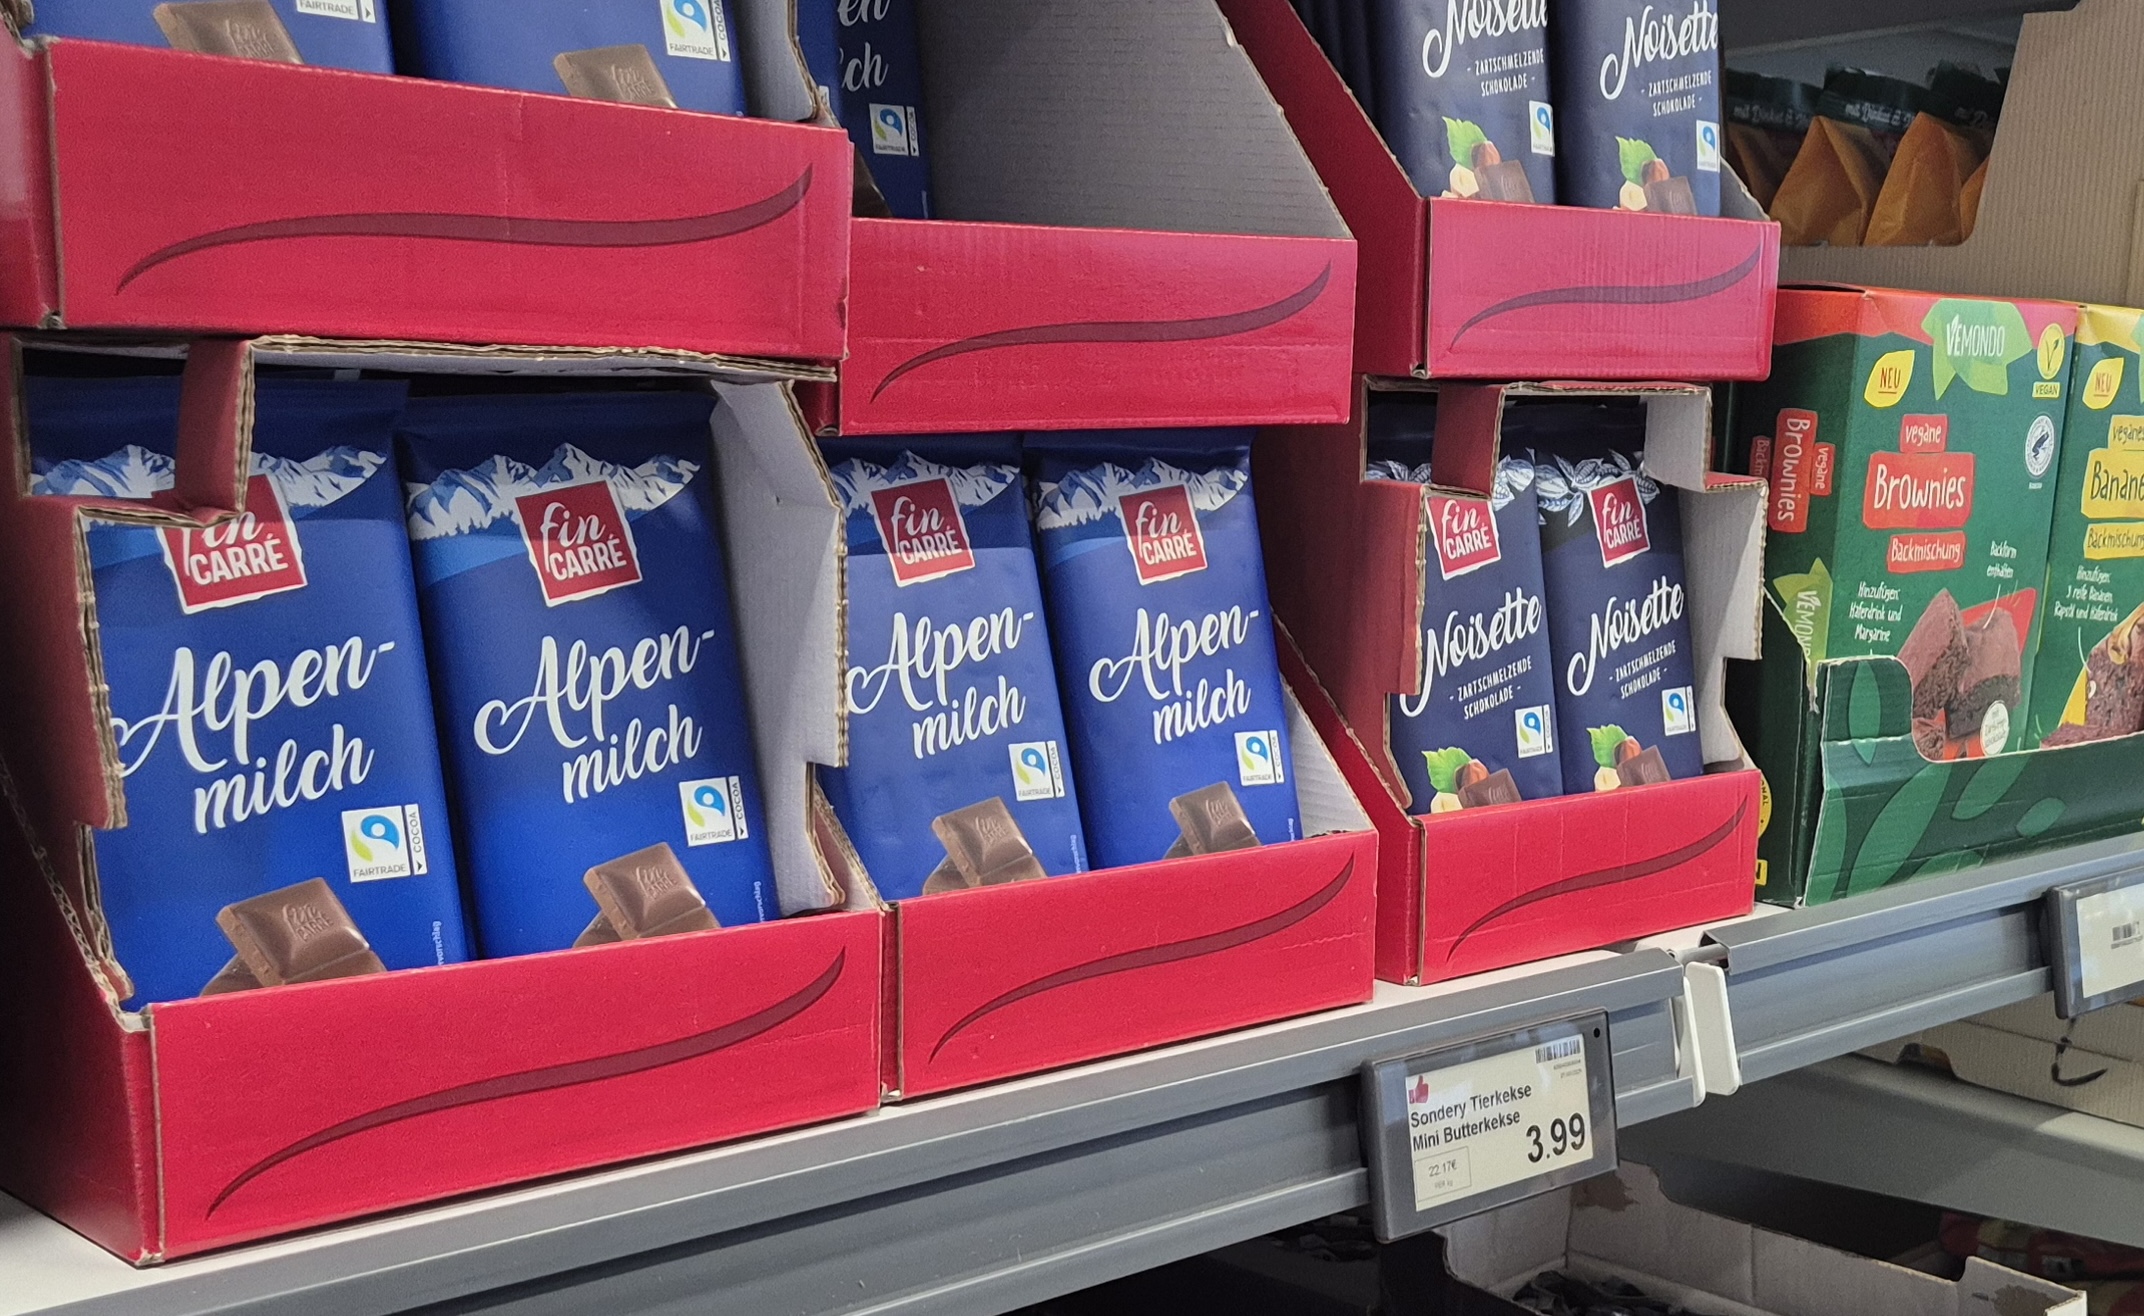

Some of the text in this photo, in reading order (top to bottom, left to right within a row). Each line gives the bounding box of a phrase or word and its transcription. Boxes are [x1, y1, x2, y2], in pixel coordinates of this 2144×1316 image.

[299, 0, 356, 15] FAIRTRADE
[669, 43, 714, 56] FAIRTRADE
[1474, 48, 1545, 76] ZARTSCHMELZENDE
[1481, 73, 1528, 97] SCHOKOLADE
[1648, 70, 1712, 97] ZARTSCHMELZENDE
[1653, 95, 1696, 117] SCHOKOLADE
[1946, 313, 2006, 357] VEMONDO
[1879, 366, 1902, 389] NEU
[2035, 384, 2059, 396] VEGAN
[2094, 372, 2112, 393] NEU
[1905, 423, 1942, 447] vegane
[1777, 418, 1811, 522] Brownies
[1815, 447, 1829, 490] vegane
[1873, 463, 1966, 511] Brownies
[540, 502, 607, 573] fin
[891, 496, 944, 557] fin
[1135, 501, 1182, 559] fin
[1441, 499, 1480, 554] fin
[1602, 492, 1635, 544] fin
[1606, 514, 1643, 550] CARRÉ
[190, 533, 289, 586] CARRÉ
[549, 533, 627, 581] CARRÉ
[899, 525, 962, 565] CARRÉ
[1142, 530, 1197, 565] CARRÉ
[1445, 522, 1492, 560] CARRÉ
[1891, 537, 1961, 563] Backmischung
[1849, 601, 1903, 622] Haferdrink und
[1088, 605, 1259, 702] Alpen-
[1400, 587, 1542, 718] Noisette
[1566, 575, 1684, 696] Noisette
[1854, 623, 1891, 644] Margarine
[845, 607, 1035, 714] Alpen-
[1457, 655, 1533, 702] ZARTSCHMELZENDE
[1615, 640, 1677, 680] ZARTSCHMELZENDE
[473, 625, 715, 755] Alpen-
[1463, 685, 1514, 720] SCHOKOLADE
[1620, 667, 1661, 700] SCHOKOLADE
[110, 636, 395, 778] Alpen-
[912, 675, 1026, 759] milch
[1152, 668, 1251, 744] milch
[562, 704, 703, 803] milch
[194, 723, 375, 834] milch
[732, 782, 743, 820] COCOA
[409, 811, 422, 853] COCOA
[690, 829, 732, 841] FAIRTRADE
[353, 864, 407, 878] FAIRTRADE
[1410, 1083, 1532, 1128] Sondery Tierkekse
[1413, 1110, 1521, 1152] Mini Butterkekse
[1526, 1112, 1586, 1164] 3.99
